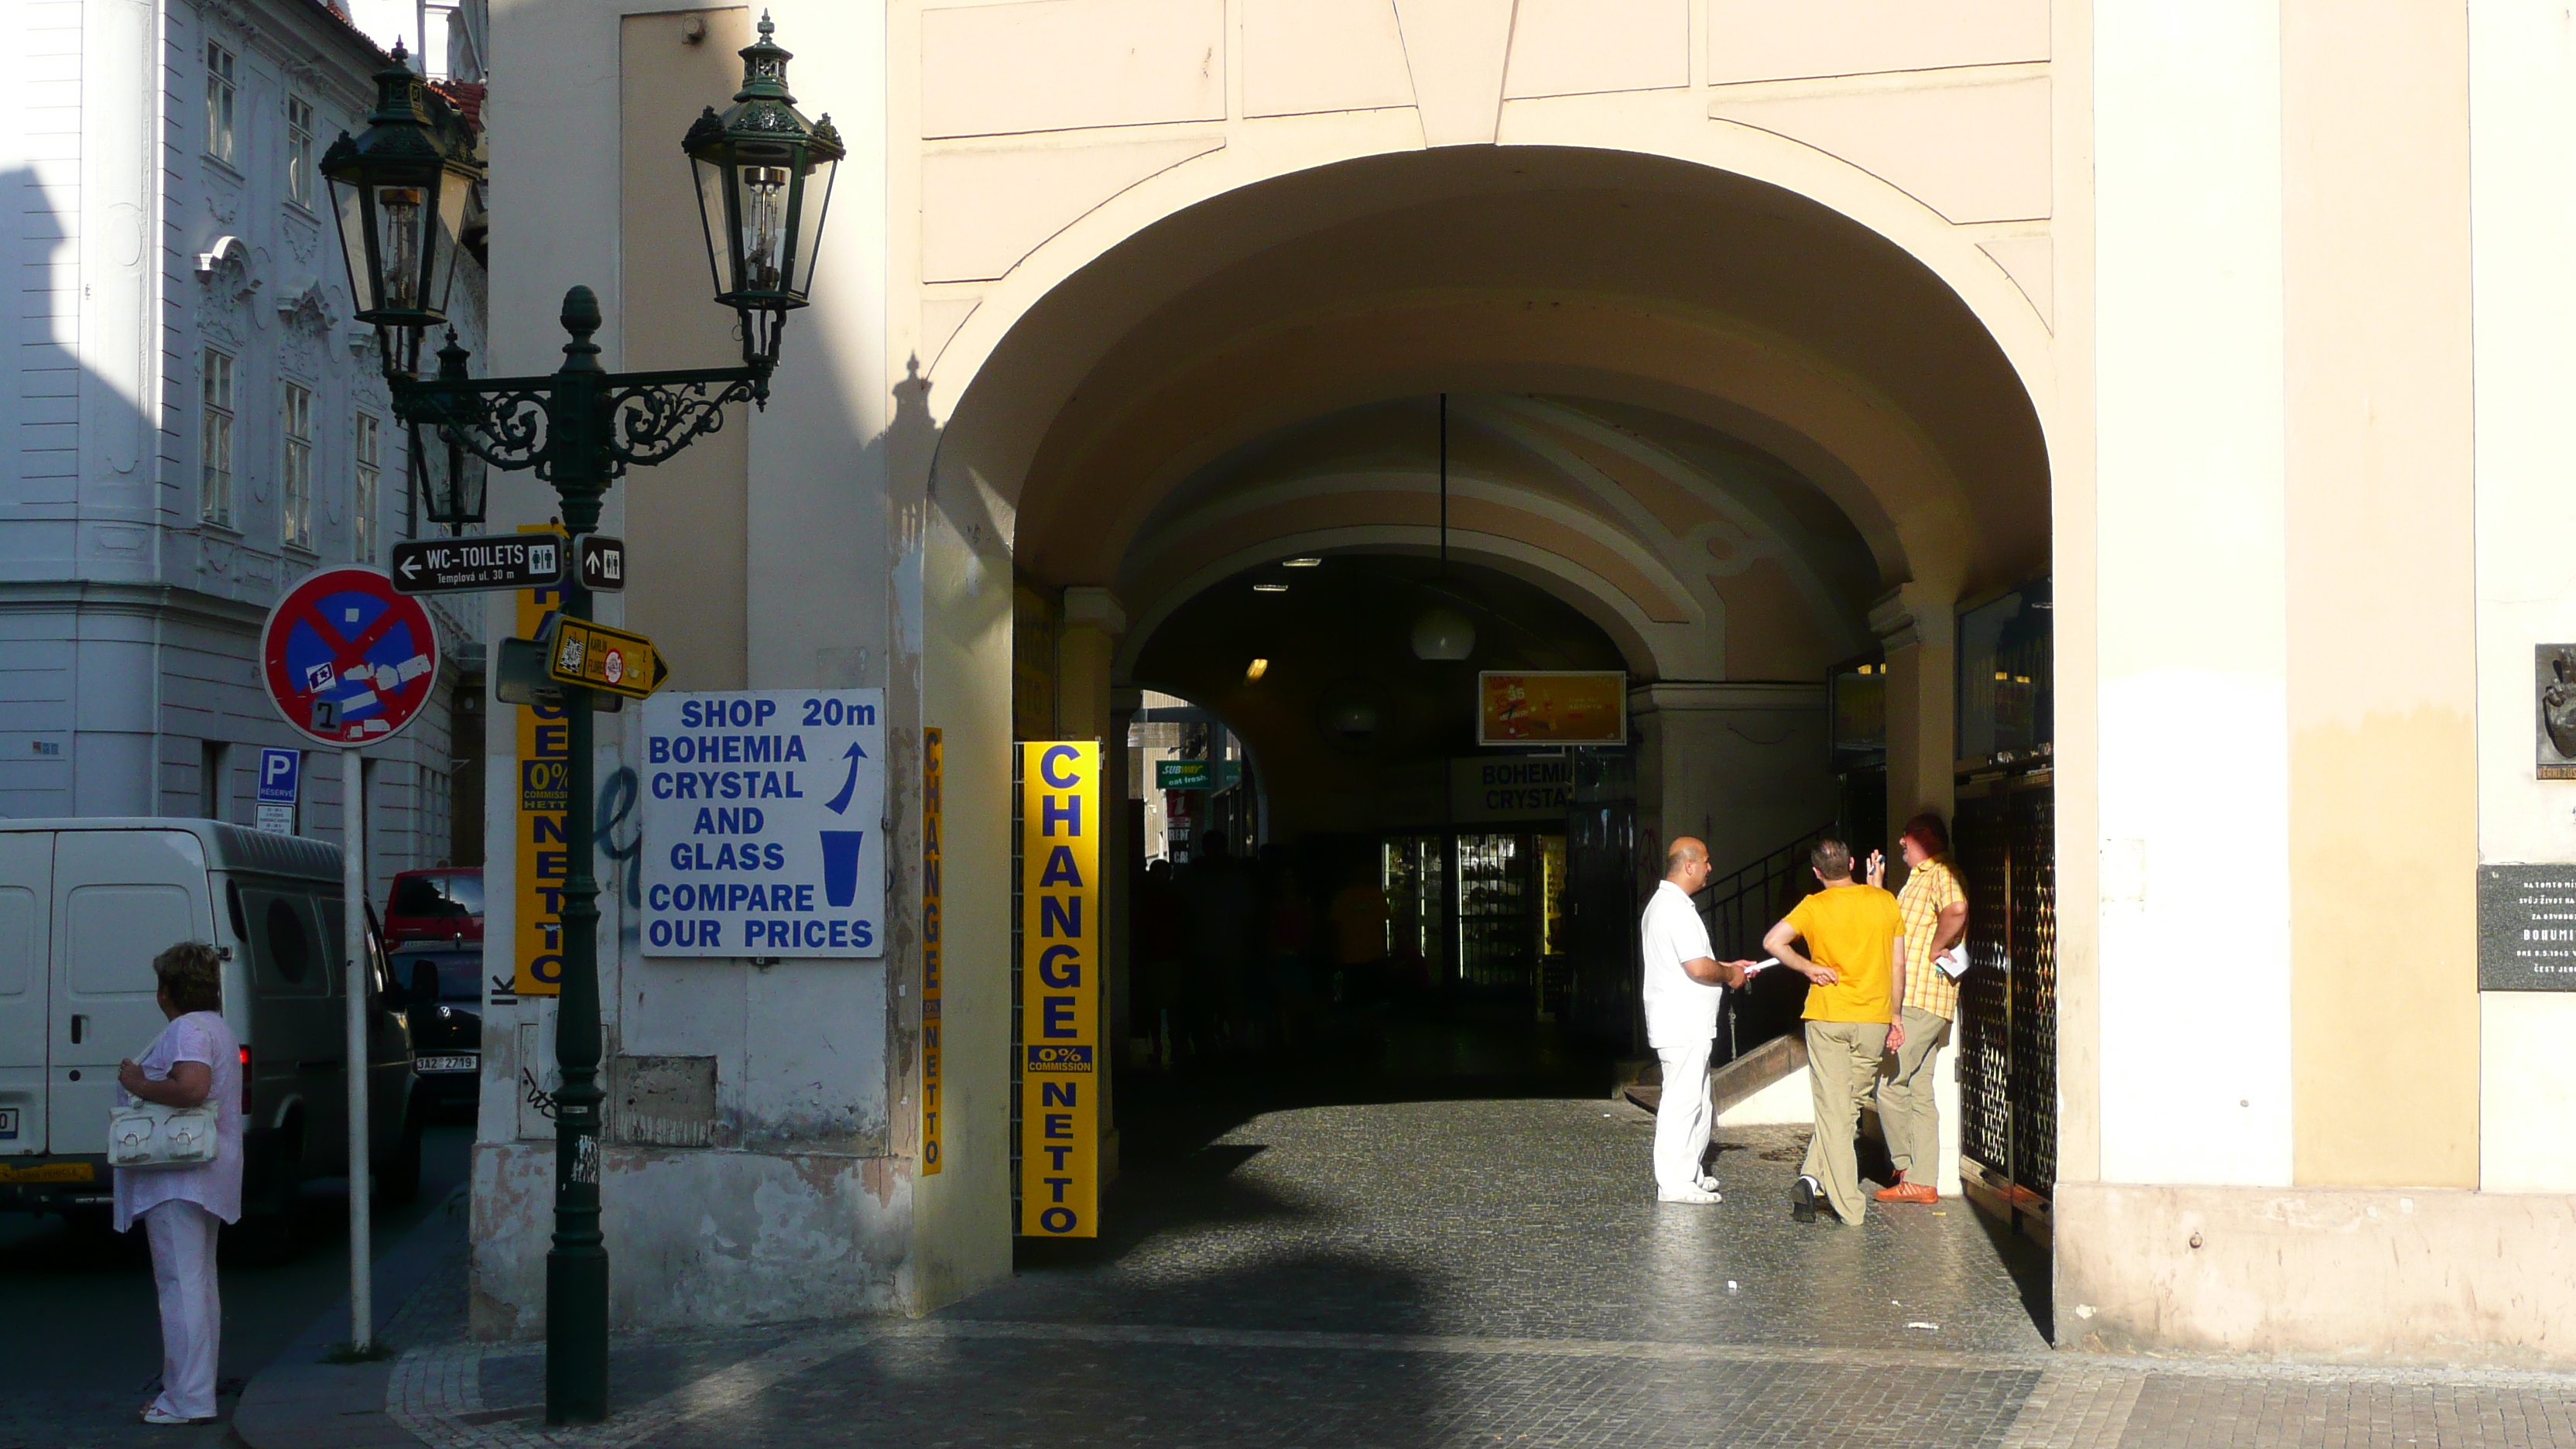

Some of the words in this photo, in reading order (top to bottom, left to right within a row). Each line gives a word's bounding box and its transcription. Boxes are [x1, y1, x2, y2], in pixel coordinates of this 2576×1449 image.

[426, 544, 524, 570] WC-TOILETS
[437, 570, 475, 585] Templová
[479, 570, 489, 581] ul.
[493, 570, 503, 580] 30
[506, 571, 515, 580] m
[587, 659, 604, 674] FLORE
[681, 700, 776, 728] SHOP
[802, 698, 875, 726] 20m
[649, 735, 807, 763] BOHEMIA
[266, 755, 291, 785] P
[1162, 765, 1204, 774] SUBWAY
[524, 790, 568, 799] COMMISSI
[652, 771, 803, 800] CRYSTAL
[694, 807, 765, 834] AND
[1168, 829, 1190, 841] RENT
[670, 843, 785, 871] GLASS
[924, 732, 940, 988] CHANGE
[649, 884, 814, 911] COMPARE
[1039, 745, 1084, 1038] CHANGE
[649, 920, 721, 947] OUR
[745, 920, 873, 948] PRICES
[418, 1058, 437, 1069] 3A2
[446, 1057, 472, 1068] 2719
[1029, 1062, 1091, 1071] COMMISSION
[1039, 1048, 1081, 1061] 0%
[925, 1026, 938, 1164] NETTO
[1040, 1082, 1077, 1233] NETTO
